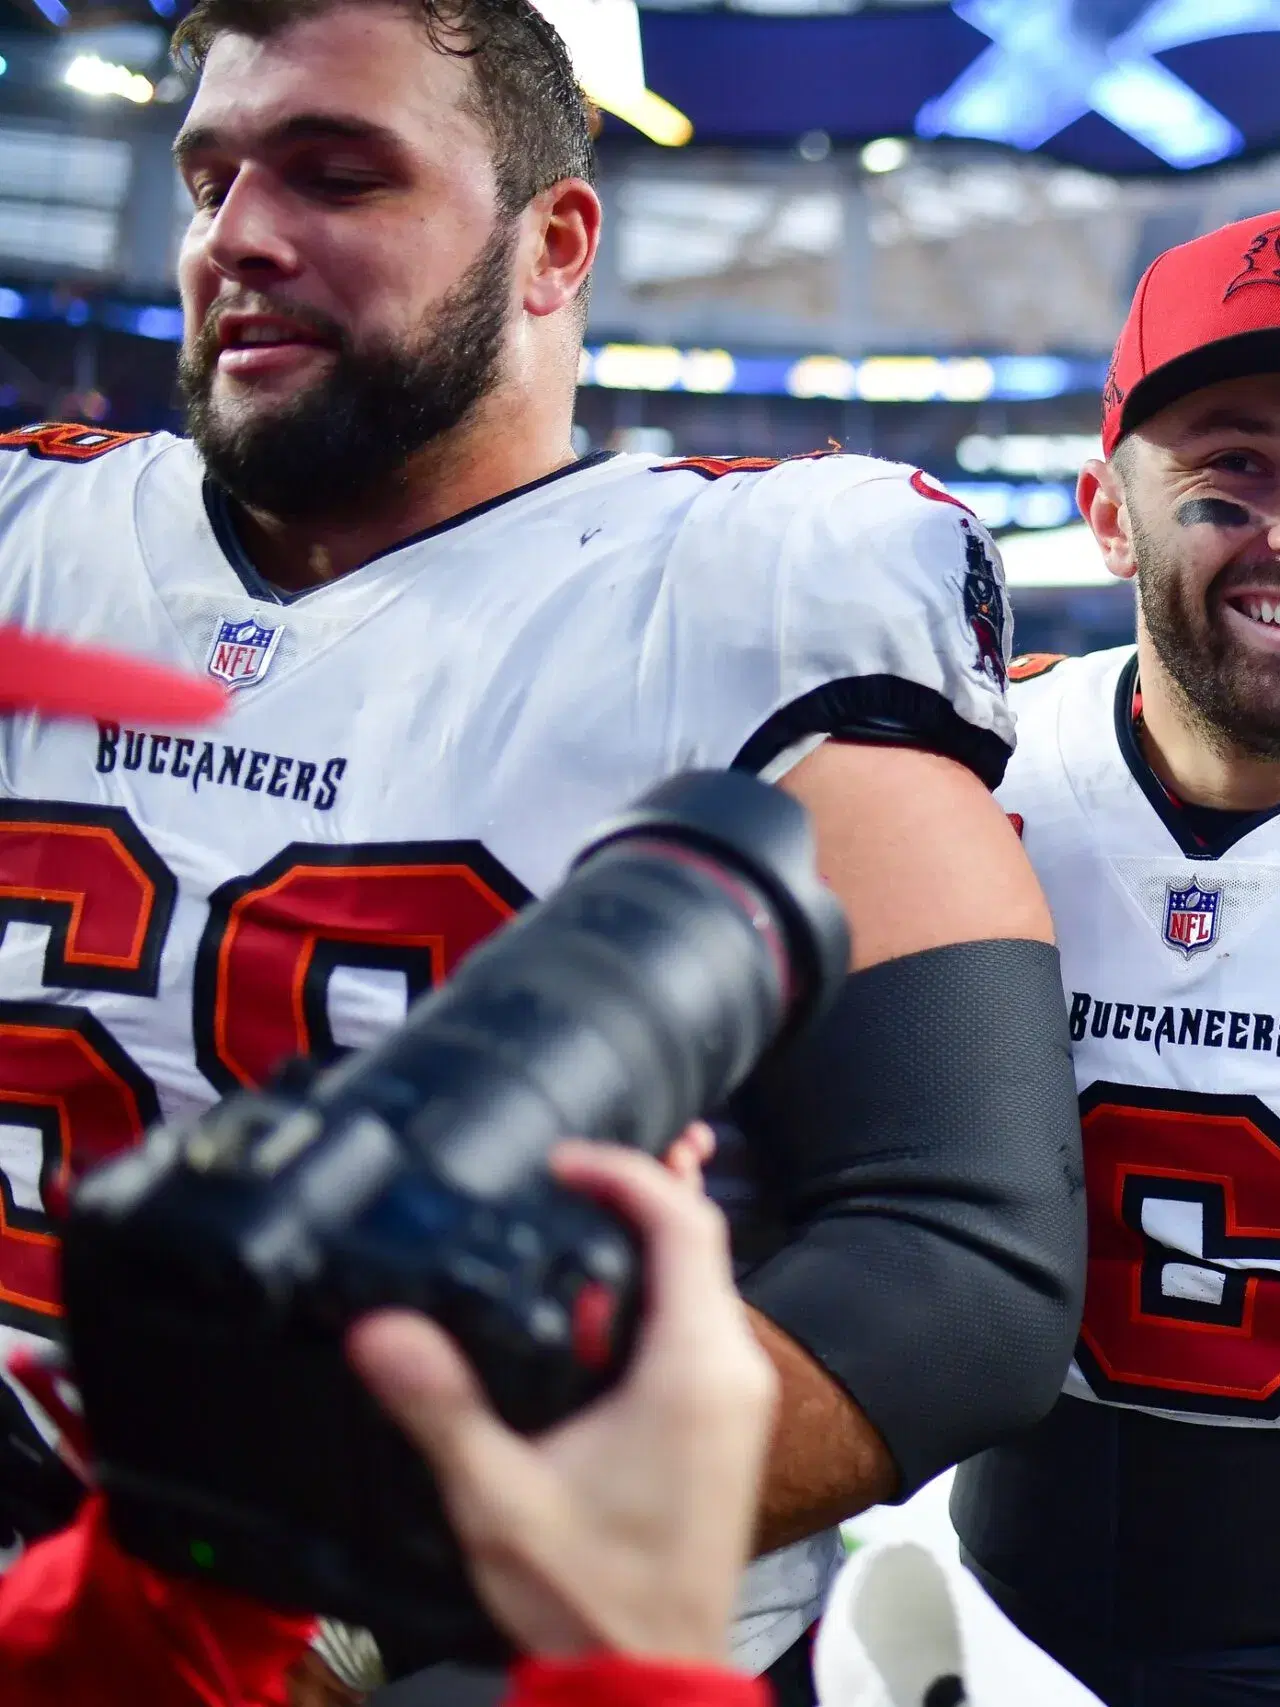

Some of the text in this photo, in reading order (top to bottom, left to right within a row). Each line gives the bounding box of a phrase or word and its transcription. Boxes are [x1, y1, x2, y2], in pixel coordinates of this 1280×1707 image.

[212, 644, 258, 678] NFL
[95, 717, 347, 811] BUCCANEERS
[1169, 911, 1210, 944] NFL
